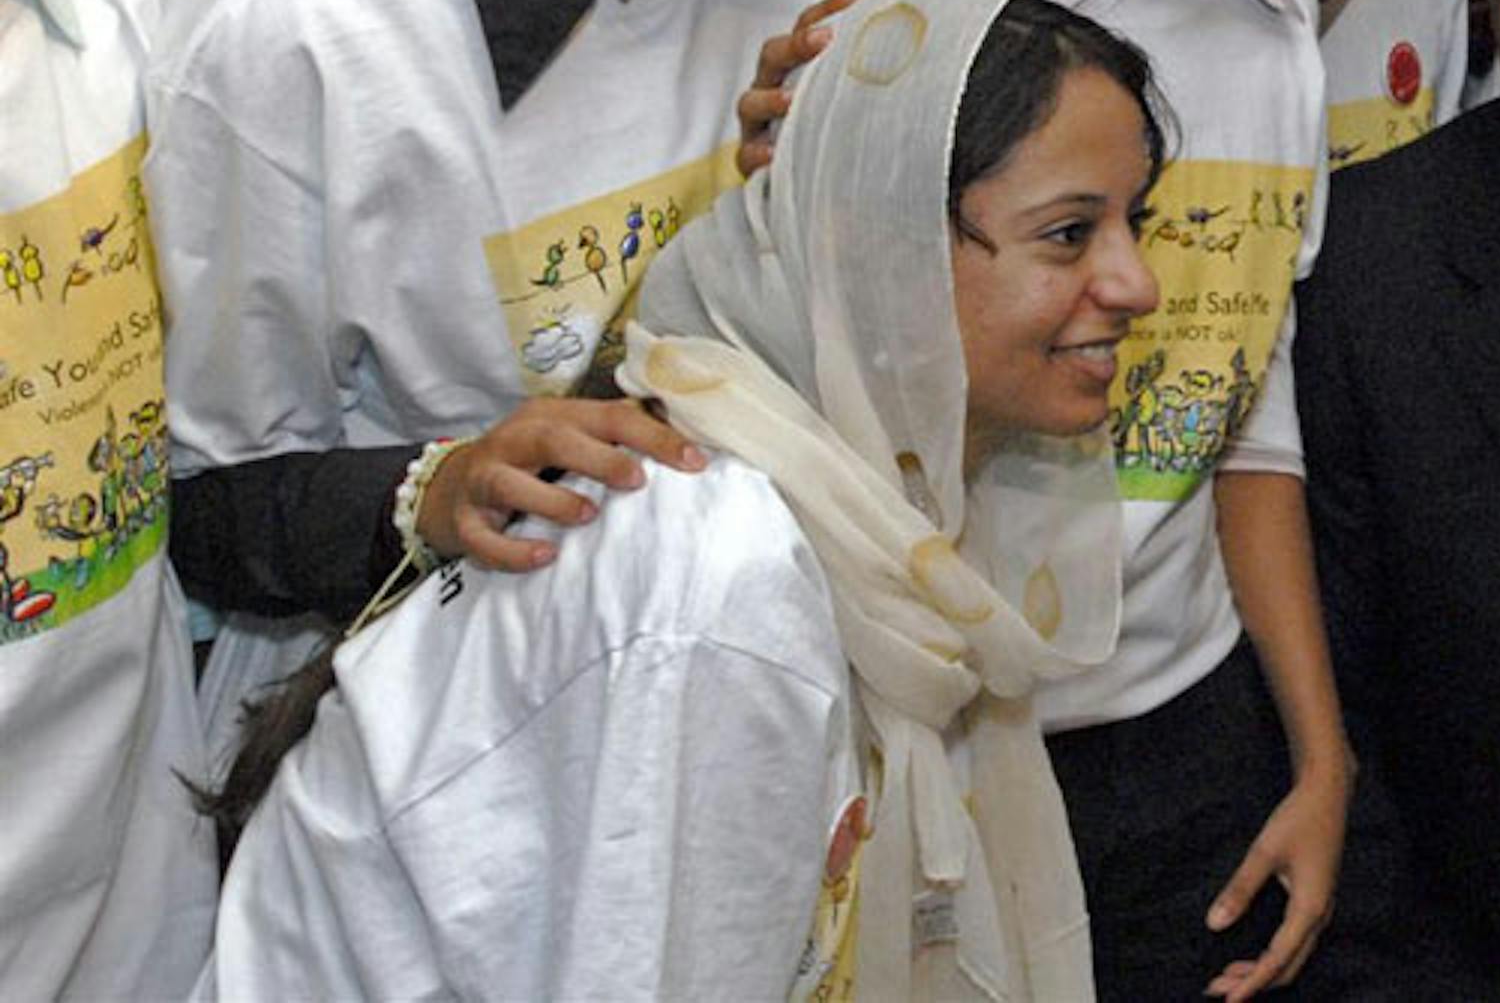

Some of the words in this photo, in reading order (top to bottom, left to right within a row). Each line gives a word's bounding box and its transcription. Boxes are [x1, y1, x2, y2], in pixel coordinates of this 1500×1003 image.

[1167, 292, 1198, 316] and
[1204, 291, 1249, 316] Safe
[1176, 324, 1212, 341] NOT
[0, 377, 35, 410] afe
